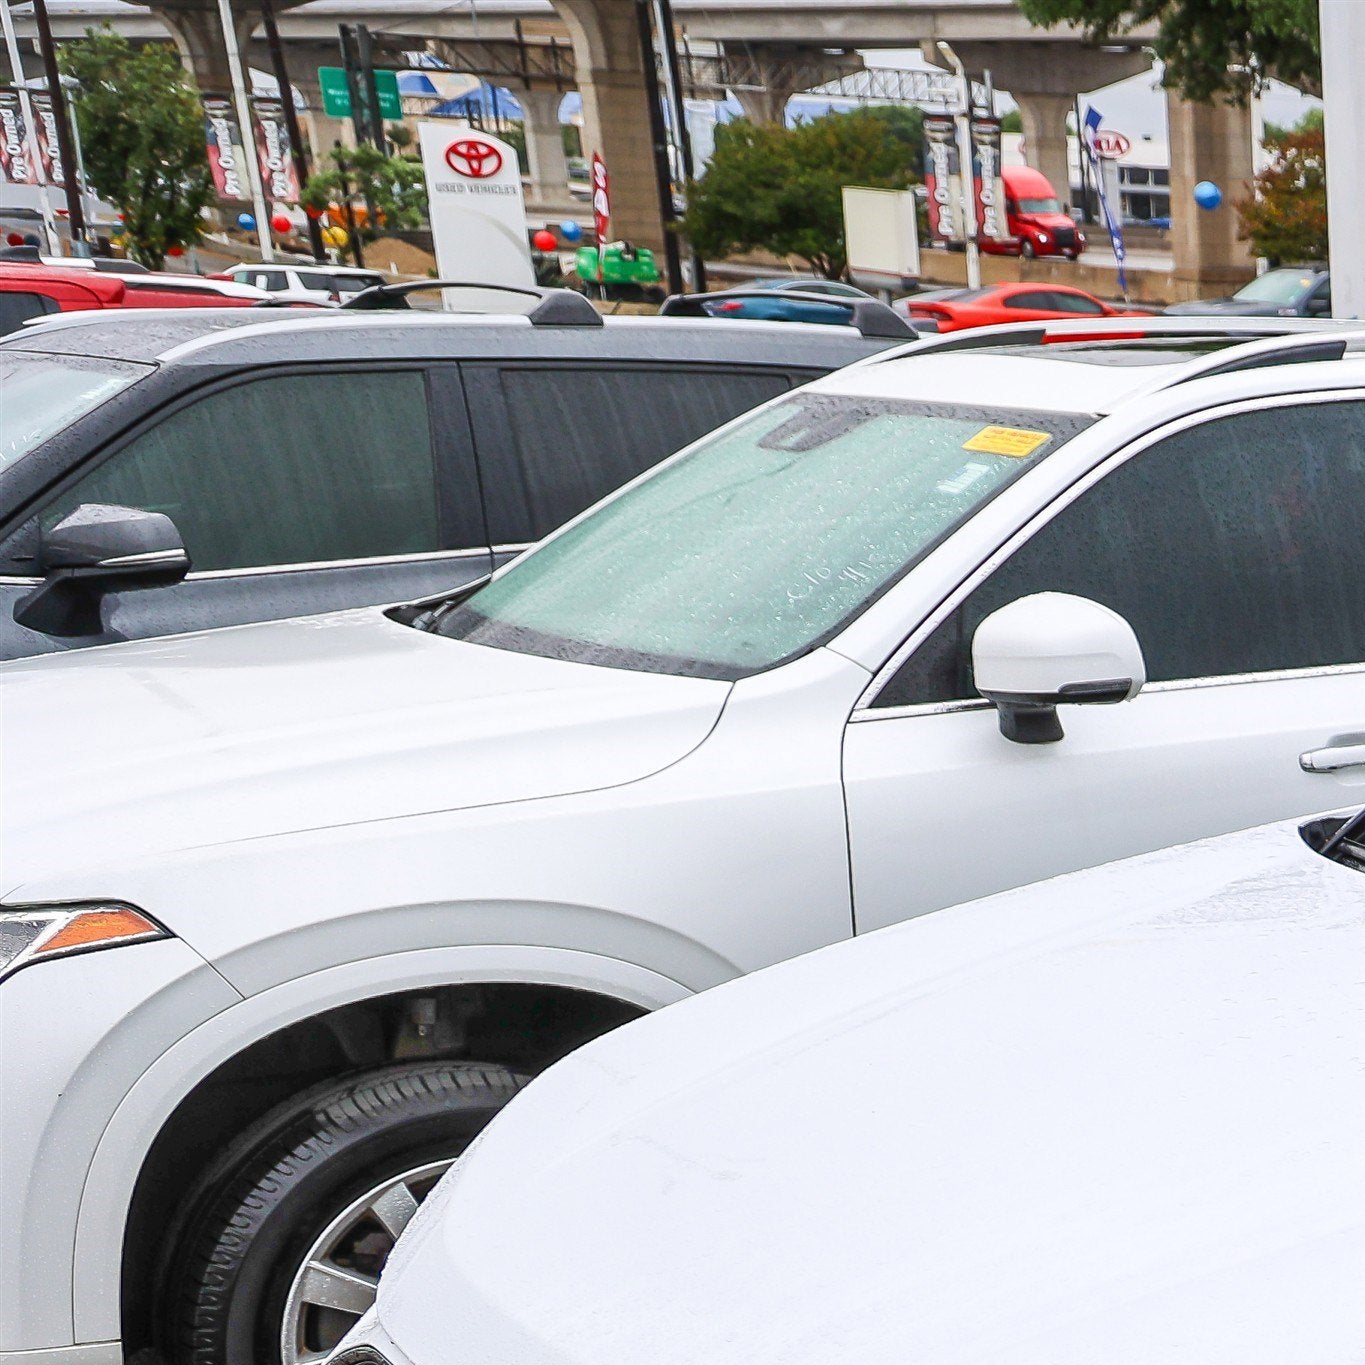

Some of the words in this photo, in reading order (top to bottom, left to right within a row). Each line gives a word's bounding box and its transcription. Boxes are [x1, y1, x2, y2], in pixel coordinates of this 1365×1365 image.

[0, 109, 21, 156] Owned
[209, 118, 235, 170] Owned
[261, 121, 283, 171] Owned
[11, 157, 27, 179] Pre
[224, 170, 241, 195] Pre
[271, 172, 289, 197] Pre
[929, 142, 950, 204] Owned
[977, 145, 995, 206] Owned
[938, 204, 955, 236] Pre
[983, 206, 998, 237] Pre
